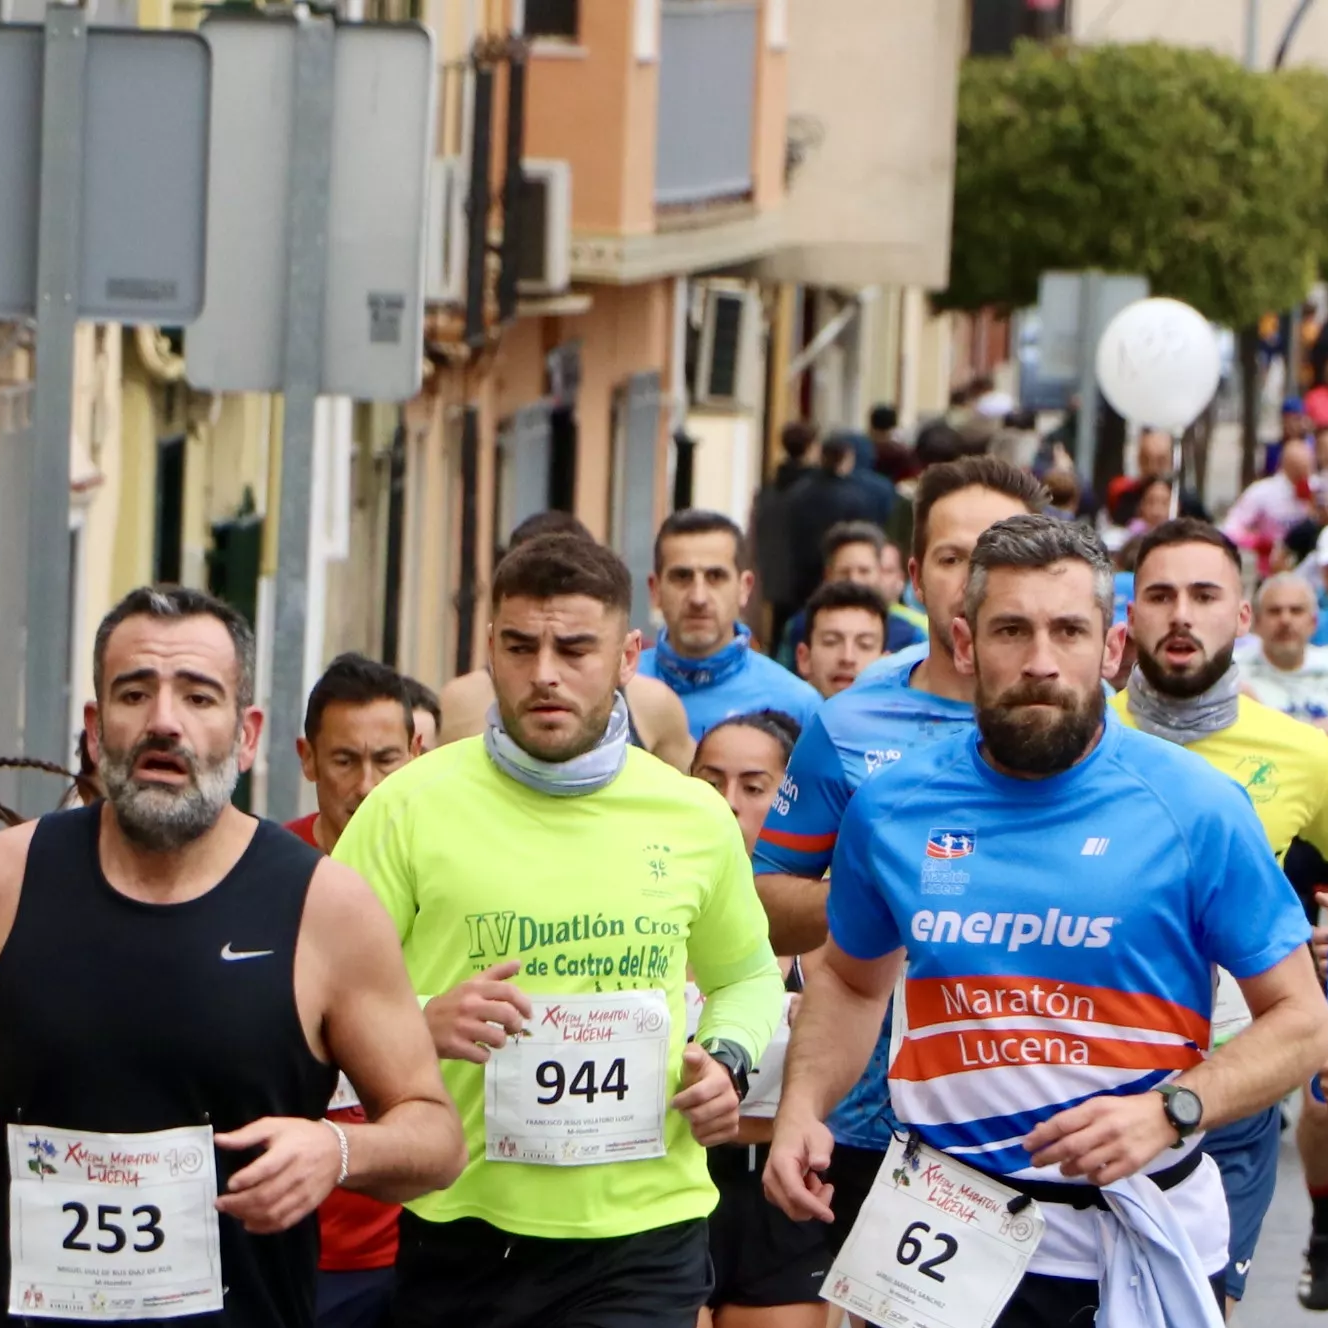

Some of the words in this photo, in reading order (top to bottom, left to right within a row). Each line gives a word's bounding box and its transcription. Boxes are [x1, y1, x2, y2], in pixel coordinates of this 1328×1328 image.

[465, 911, 516, 958] IV
[518, 913, 625, 952] Duatlón
[911, 908, 1114, 952] enerplus
[525, 958, 548, 976] de
[554, 953, 614, 976] Castro
[618, 946, 645, 977] del
[940, 983, 1095, 1021] Maratón
[563, 1026, 618, 1042] LUCENA
[958, 1033, 1090, 1066] Lucena
[536, 1057, 629, 1105] 944
[87, 1165, 144, 1187] LUCENA
[928, 1187, 979, 1223] LUCENA
[61, 1201, 166, 1254] 253
[896, 1221, 959, 1283] 62
